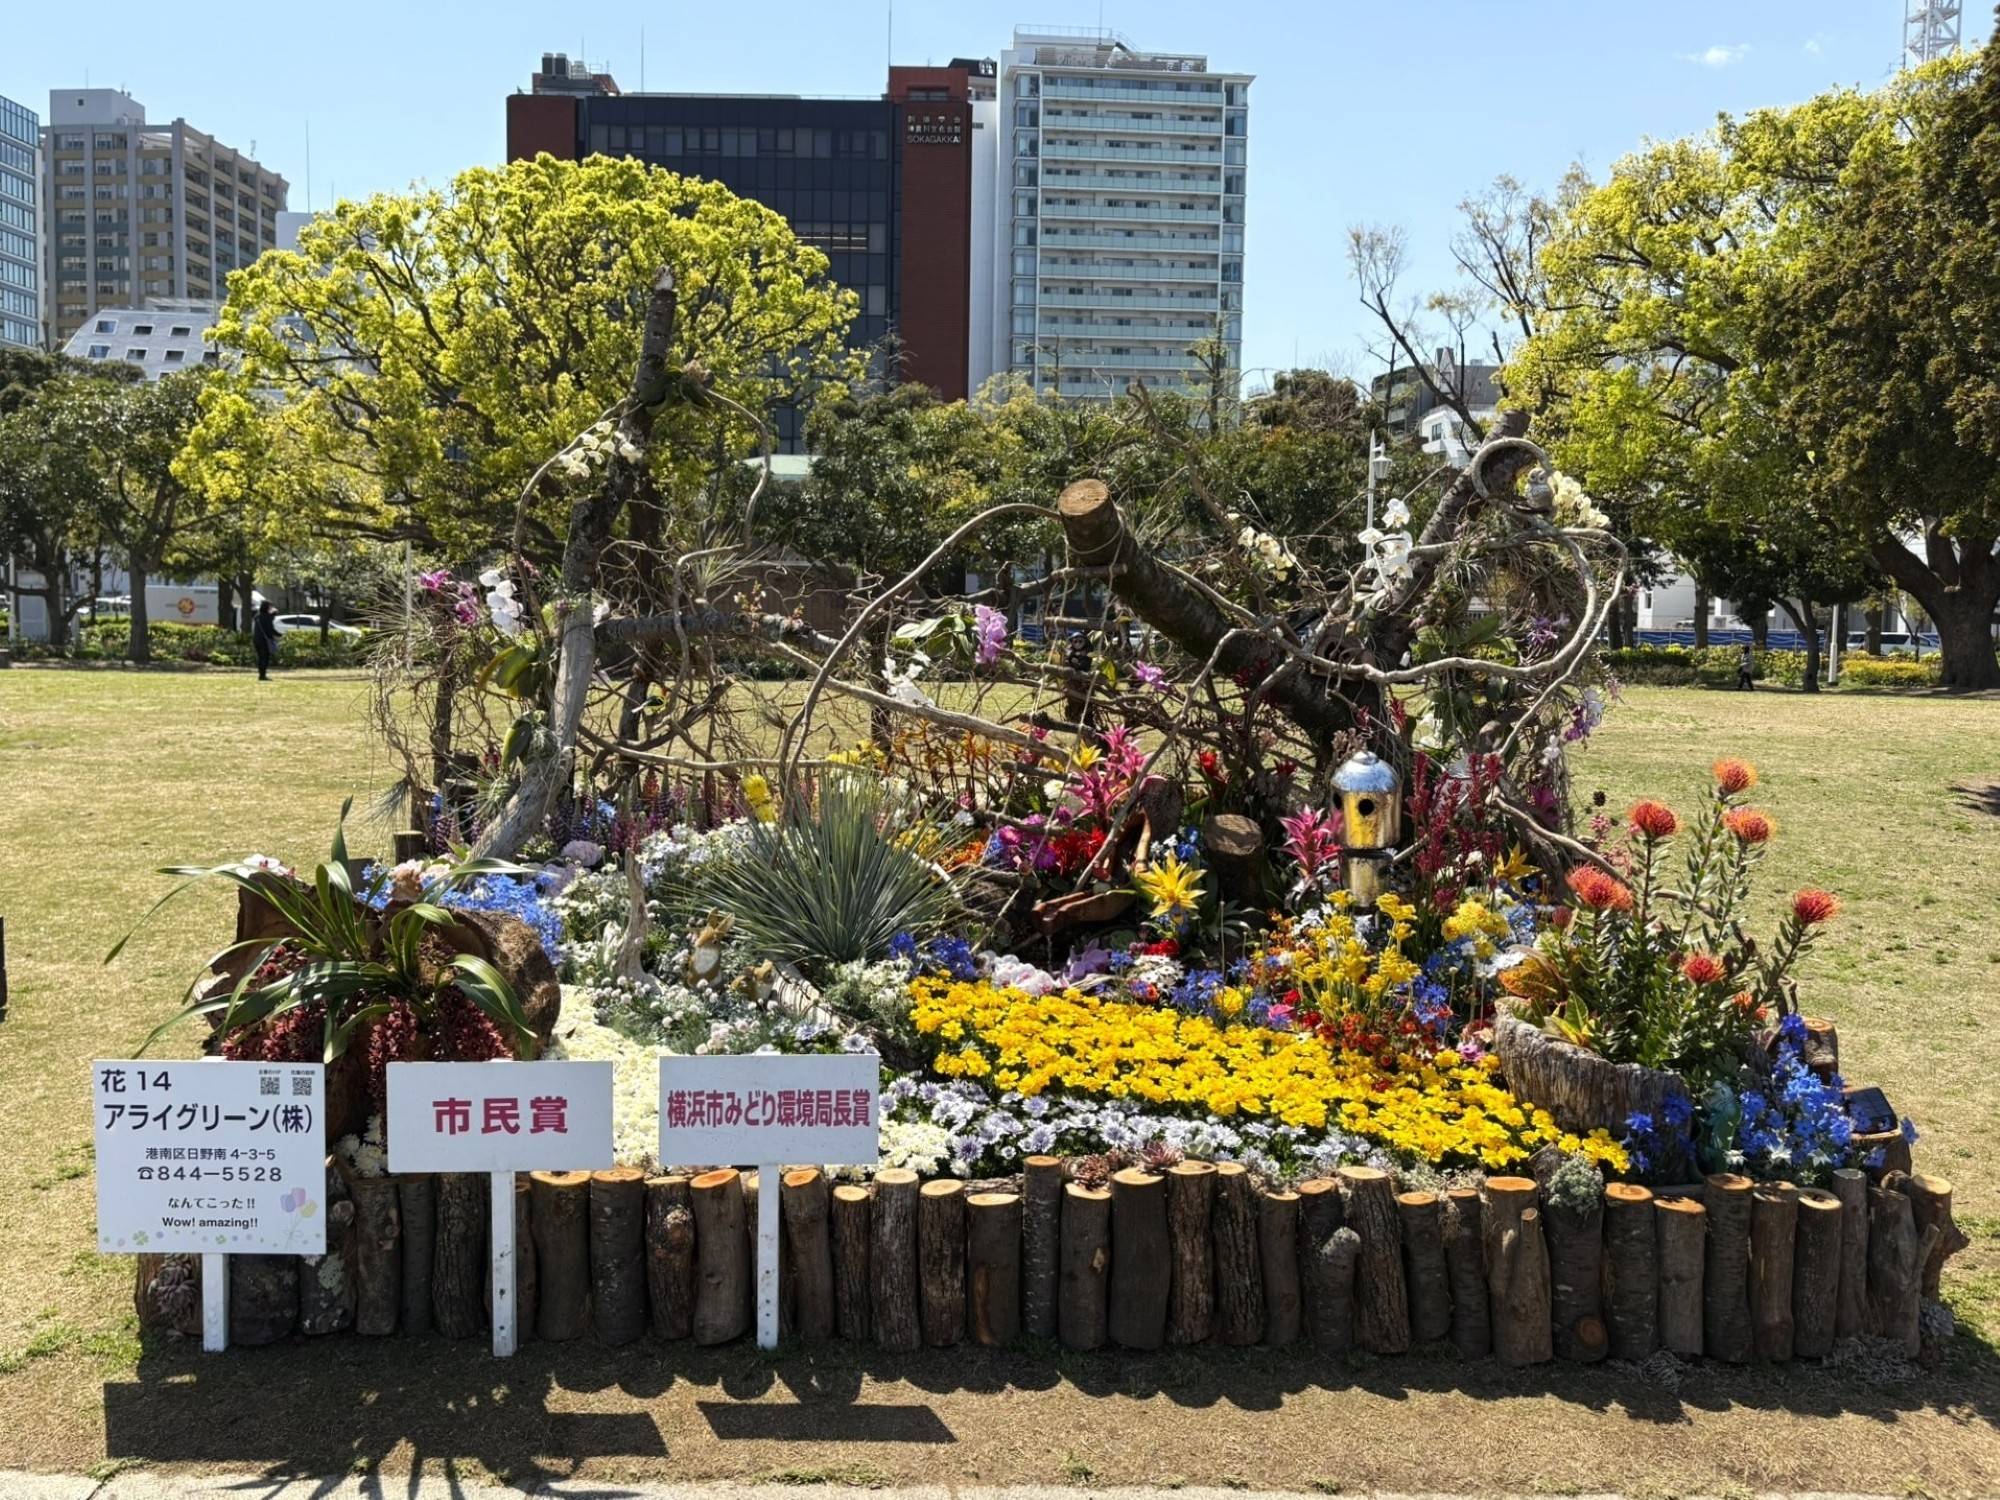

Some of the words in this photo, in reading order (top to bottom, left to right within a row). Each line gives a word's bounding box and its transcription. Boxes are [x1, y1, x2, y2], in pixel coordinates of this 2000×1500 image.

[103, 1103, 312, 1133] アライグリーン(株)
[432, 1096, 568, 1135] 市民賞
[667, 1089, 870, 1128] 横浜市みどり環境局長賞
[162, 1217, 196, 1227] Wow!
[198, 1217, 258, 1229] amazing!!
